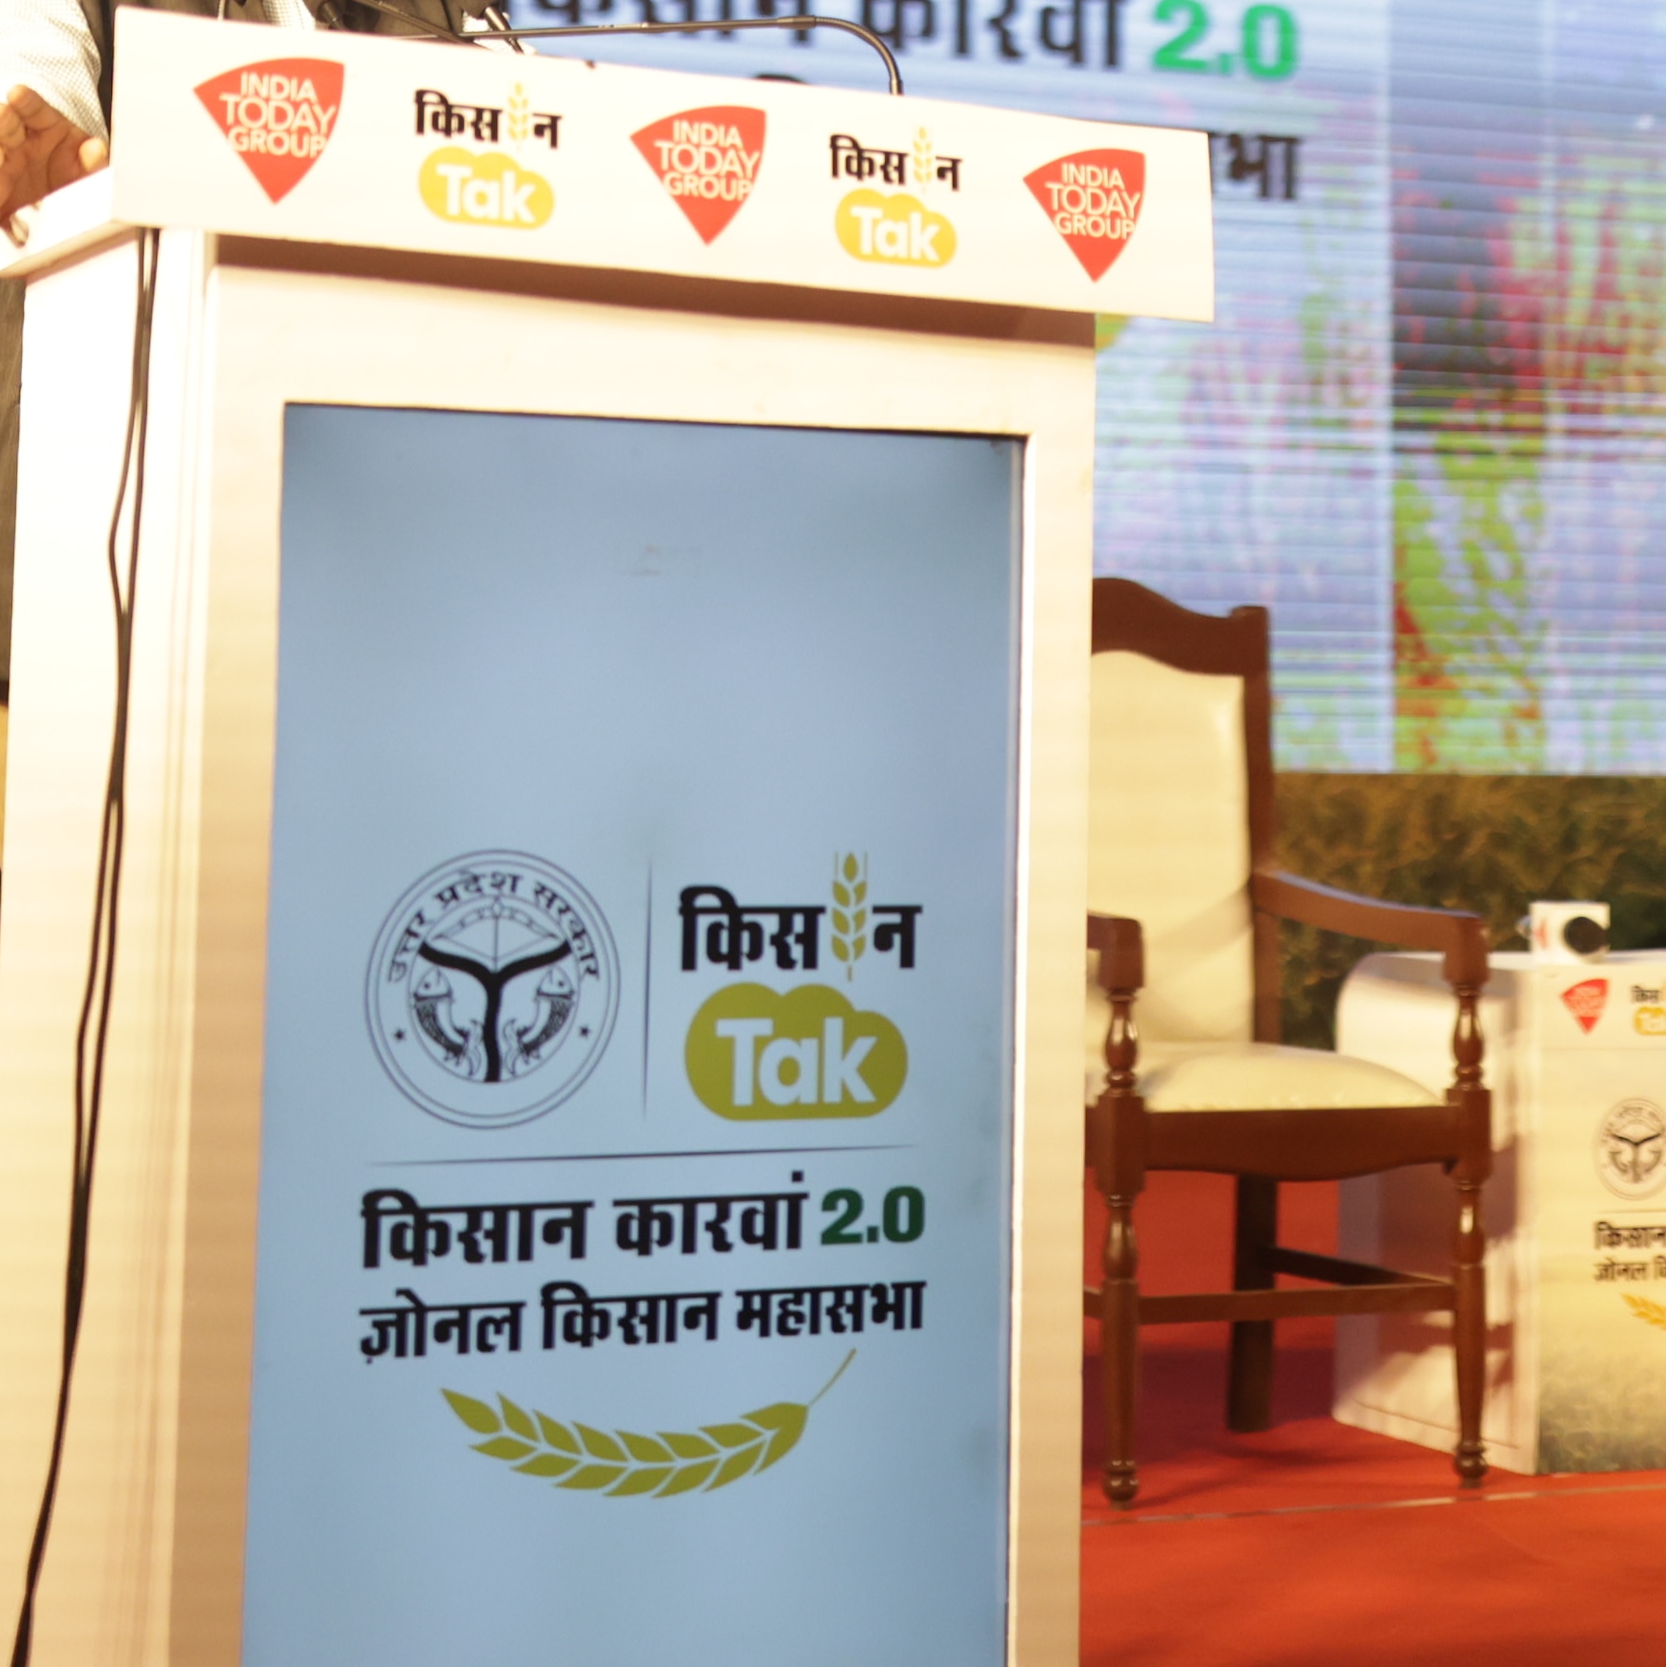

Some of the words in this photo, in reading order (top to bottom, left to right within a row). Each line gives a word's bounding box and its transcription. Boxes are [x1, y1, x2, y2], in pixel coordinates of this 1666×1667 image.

[241, 72, 317, 102] INDIA
[219, 93, 336, 132] TODAY
[230, 128, 330, 158] GROUP
[673, 120, 742, 148] INDIA
[654, 140, 760, 179] TODAY
[1062, 163, 1125, 189] INDIA
[437, 164, 535, 222] Tak
[663, 175, 752, 201] GROUP
[1046, 182, 1141, 218] TODAY
[850, 205, 942, 263] Tak
[1054, 213, 1135, 239] GROUP
[716, 1017, 880, 1107] Tak
[360, 1188, 594, 1269] किसान
[613, 1170, 809, 1256] कारवां
[820, 1186, 925, 1245] 2.0
[539, 1281, 722, 1350] किसान
[737, 1280, 927, 1337] महासभा
